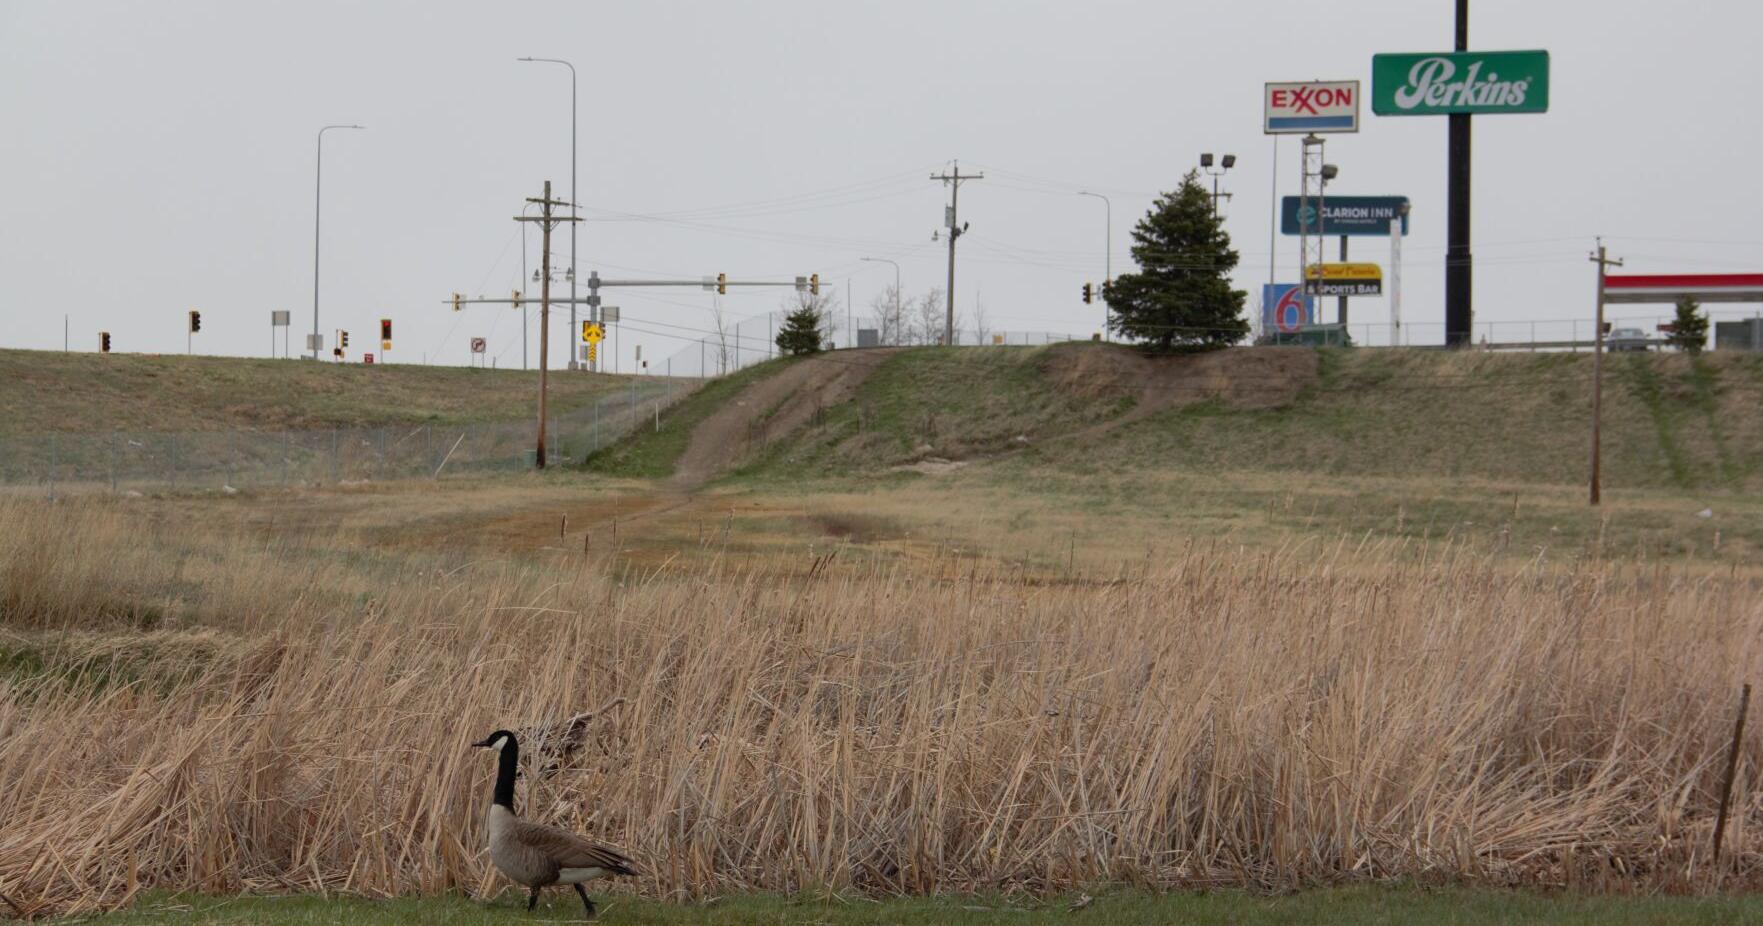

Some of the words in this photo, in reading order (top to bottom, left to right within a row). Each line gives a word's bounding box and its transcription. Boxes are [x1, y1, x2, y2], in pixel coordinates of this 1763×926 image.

[1394, 57, 1528, 109] Perkins
[1272, 86, 1351, 114] EXXON
[1319, 207, 1369, 218] CLARION
[1371, 207, 1393, 218] INN
[1357, 284, 1378, 293] BAR
[1275, 286, 1308, 333] 6
